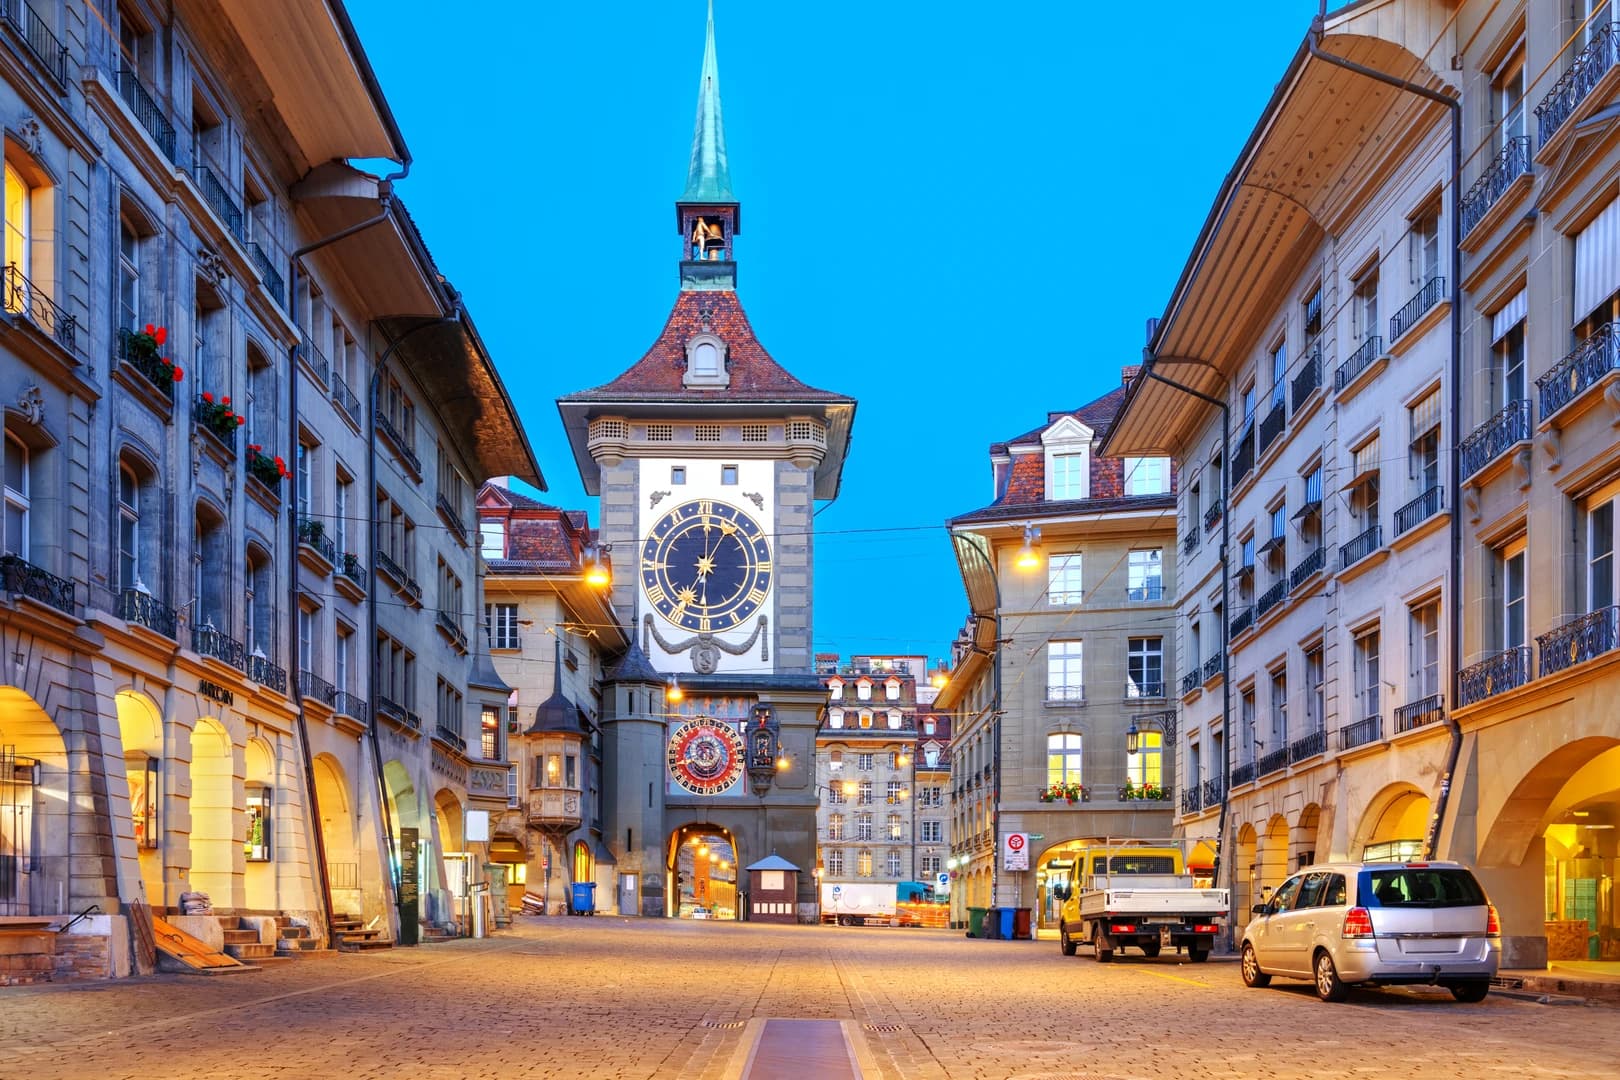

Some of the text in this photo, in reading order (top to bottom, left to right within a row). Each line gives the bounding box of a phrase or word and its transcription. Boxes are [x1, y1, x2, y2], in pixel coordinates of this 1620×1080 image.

[697, 502, 712, 514] XII
[670, 510, 684, 524] XI
[650, 532, 662, 544] X
[750, 532, 763, 543] II
[758, 561, 772, 572] III
